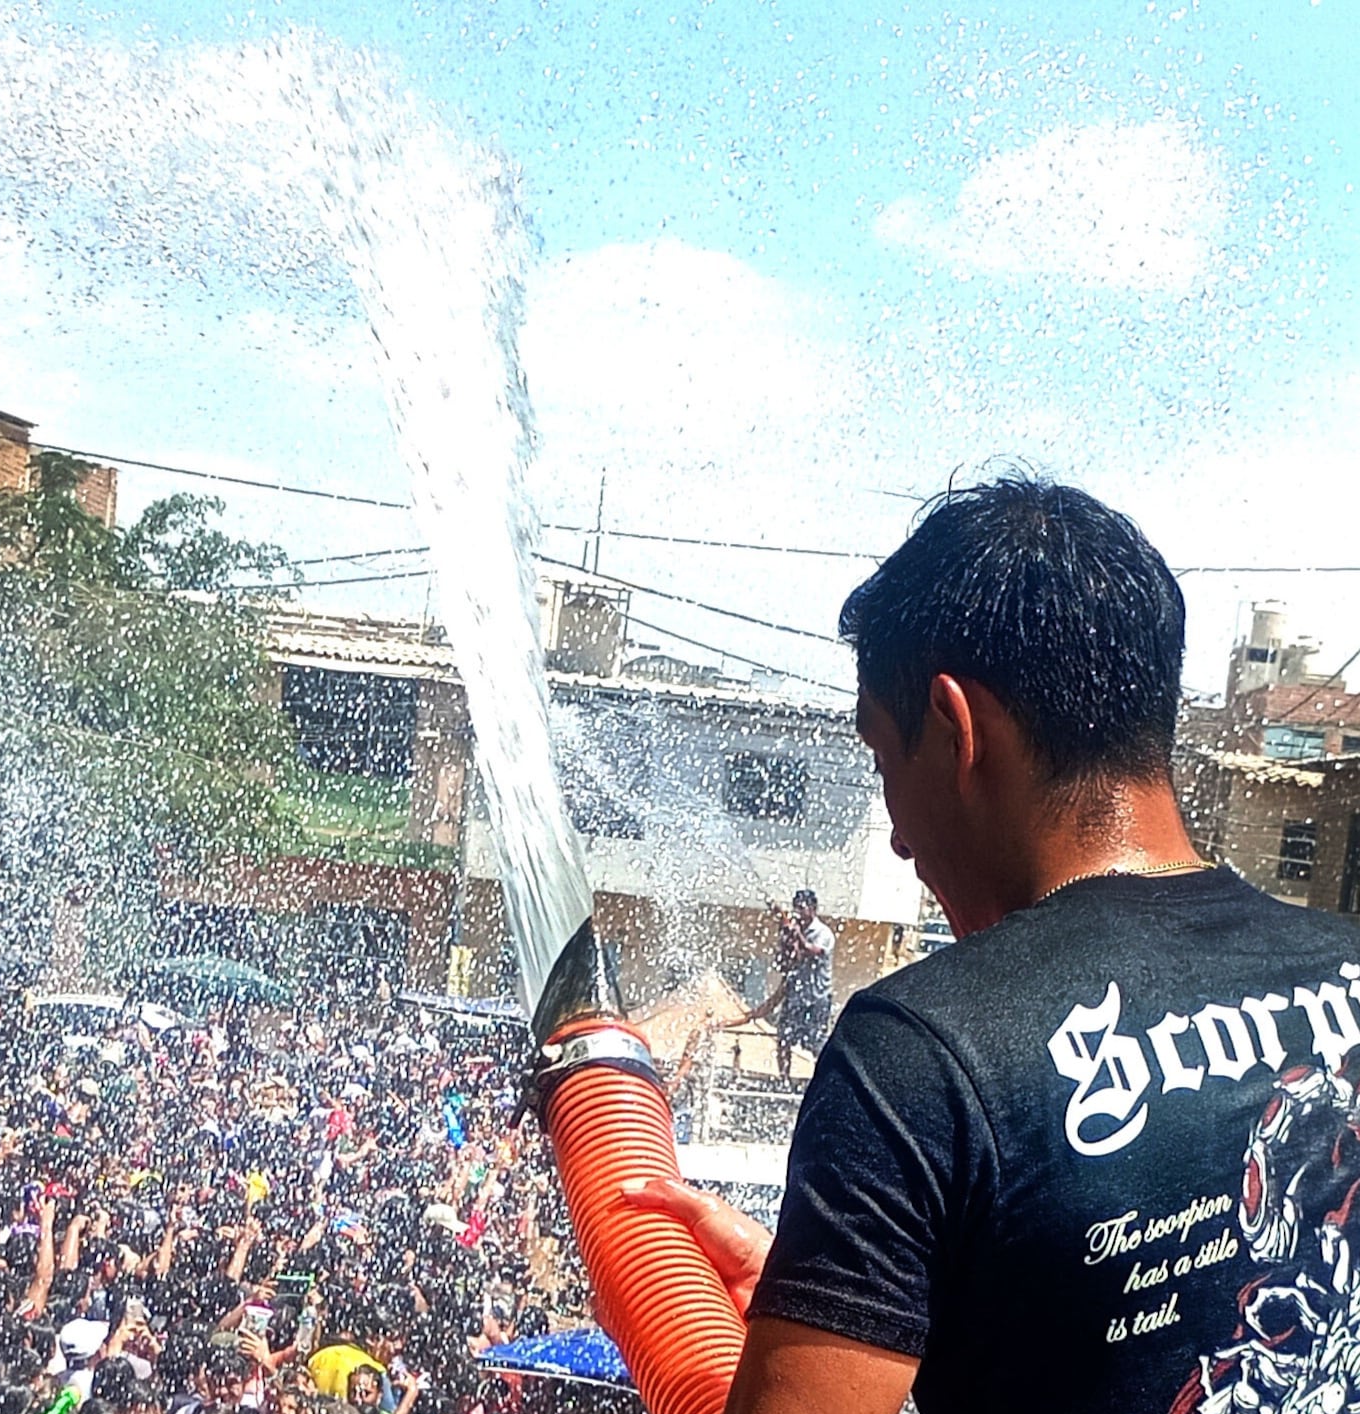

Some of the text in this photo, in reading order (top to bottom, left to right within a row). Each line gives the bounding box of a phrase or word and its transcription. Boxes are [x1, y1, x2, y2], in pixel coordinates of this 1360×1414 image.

[1084, 1194, 1232, 1265] The scorpion
[1123, 1228, 1239, 1293] has a stile
[1106, 1292, 1181, 1343] is tail.
